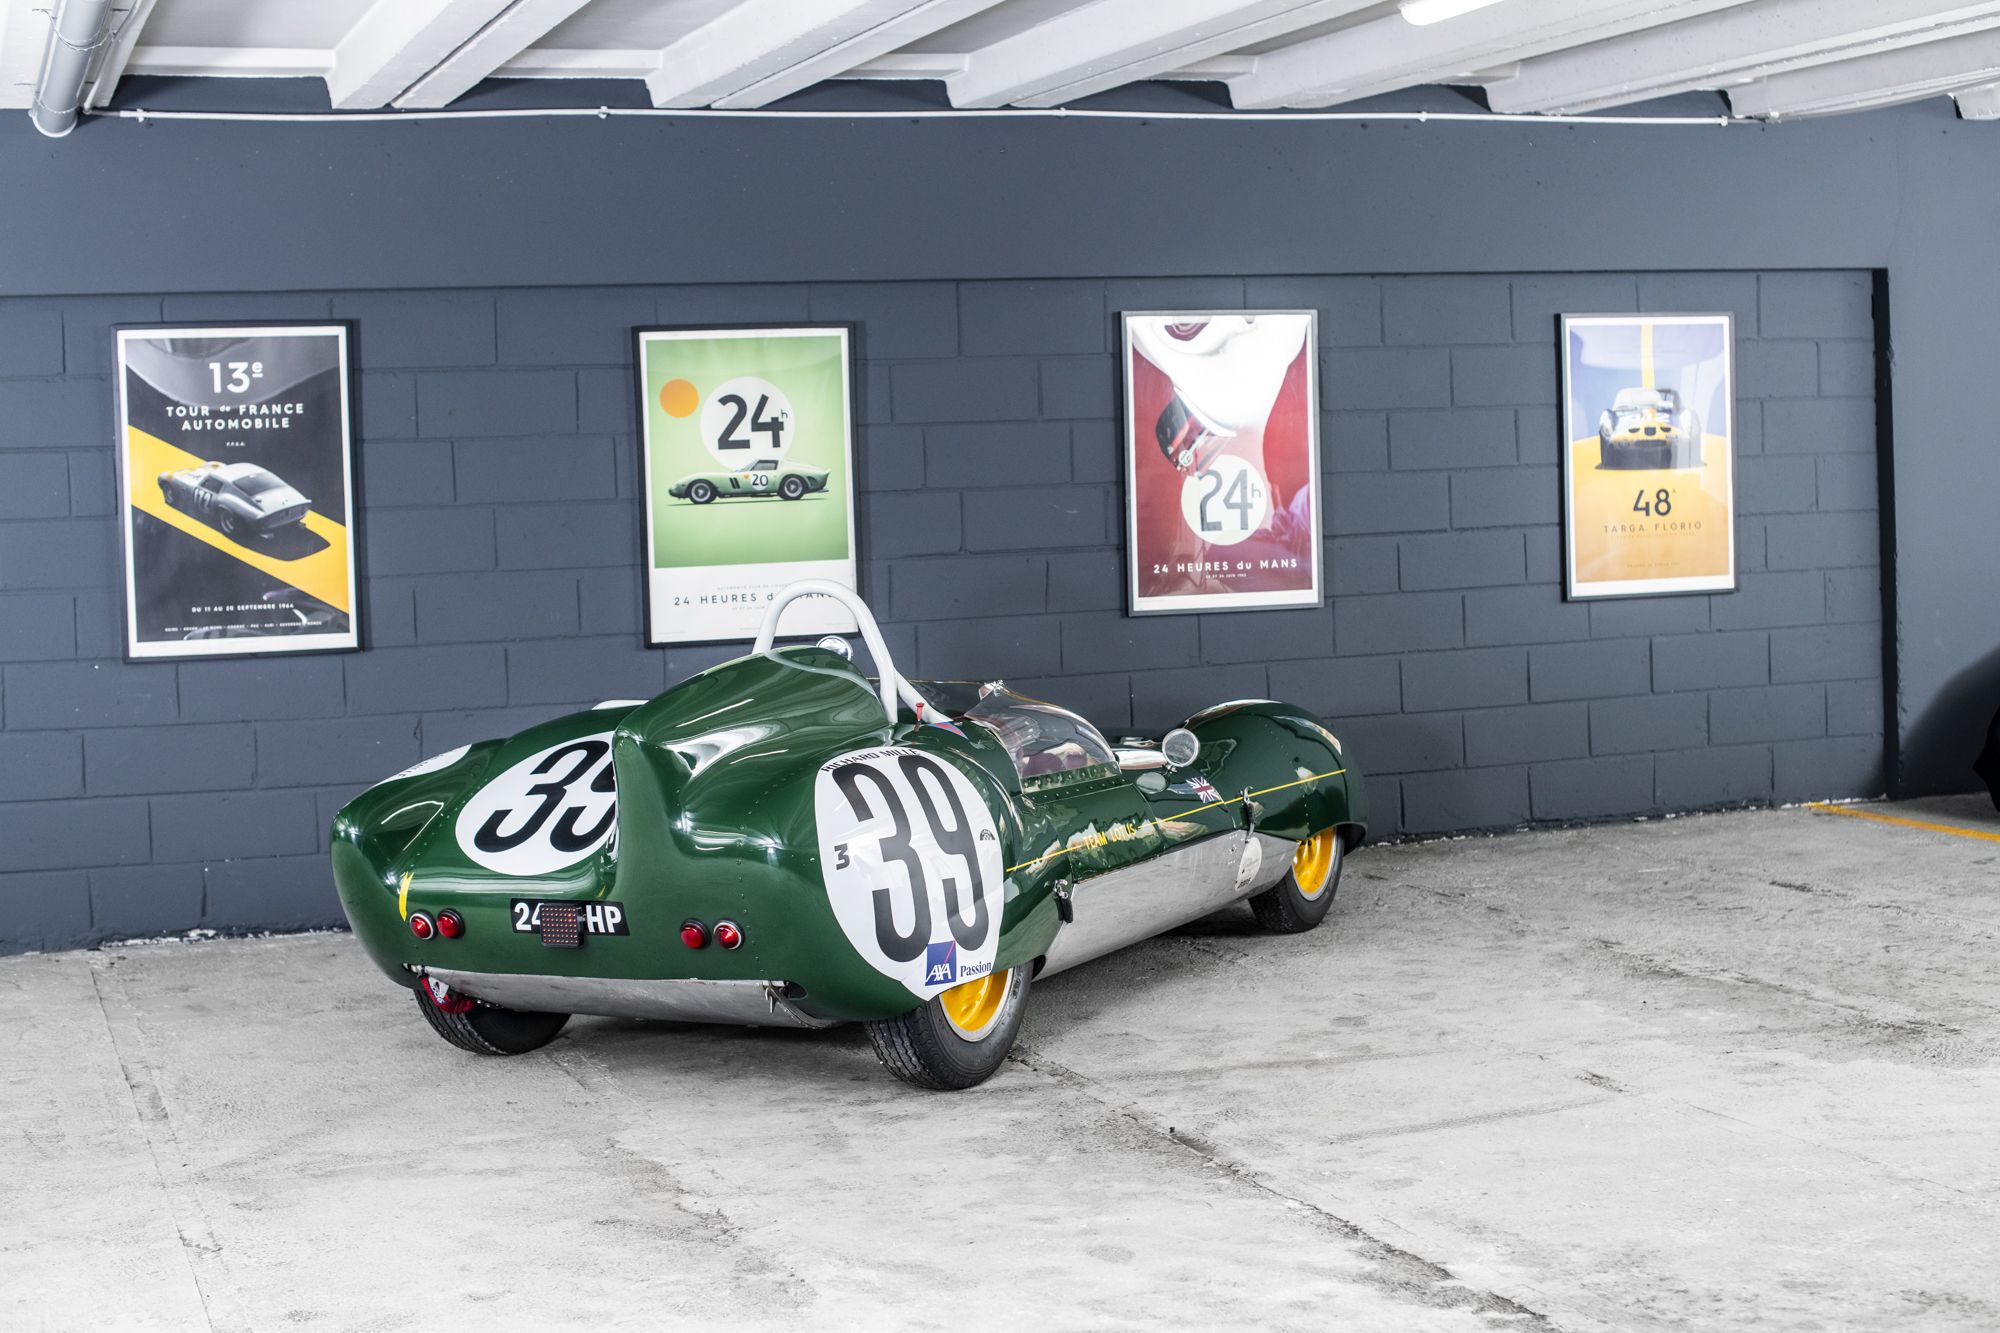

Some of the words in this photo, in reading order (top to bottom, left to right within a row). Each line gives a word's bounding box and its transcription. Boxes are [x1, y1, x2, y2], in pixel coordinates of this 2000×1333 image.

[165, 406, 209, 417] TOUR
[219, 404, 231, 412] de
[239, 403, 304, 415] FRANCE
[181, 417, 290, 431] AUTOMOBILE
[752, 474, 769, 487] 20
[1603, 524, 1645, 533] TARGA
[1654, 521, 1702, 531] FLORIO
[1153, 564, 1169, 574] 24
[1177, 561, 1229, 573] HEURES
[1236, 560, 1252, 570] du
[1260, 558, 1298, 569] MANS
[237, 603, 276, 611] SEPTEMBRE
[674, 596, 690, 606] 24
[700, 593, 757, 604] HEURES
[821, 752, 880, 772] RICHARD
[879, 748, 918, 757] MILLE
[1084, 831, 1108, 850] TEAM
[1110, 822, 1136, 842] LOTUS
[832, 755, 989, 963] 39
[834, 843, 850, 870] 3
[585, 904, 622, 933] HP
[925, 962, 952, 983] AXA
[960, 961, 992, 978] Passion
